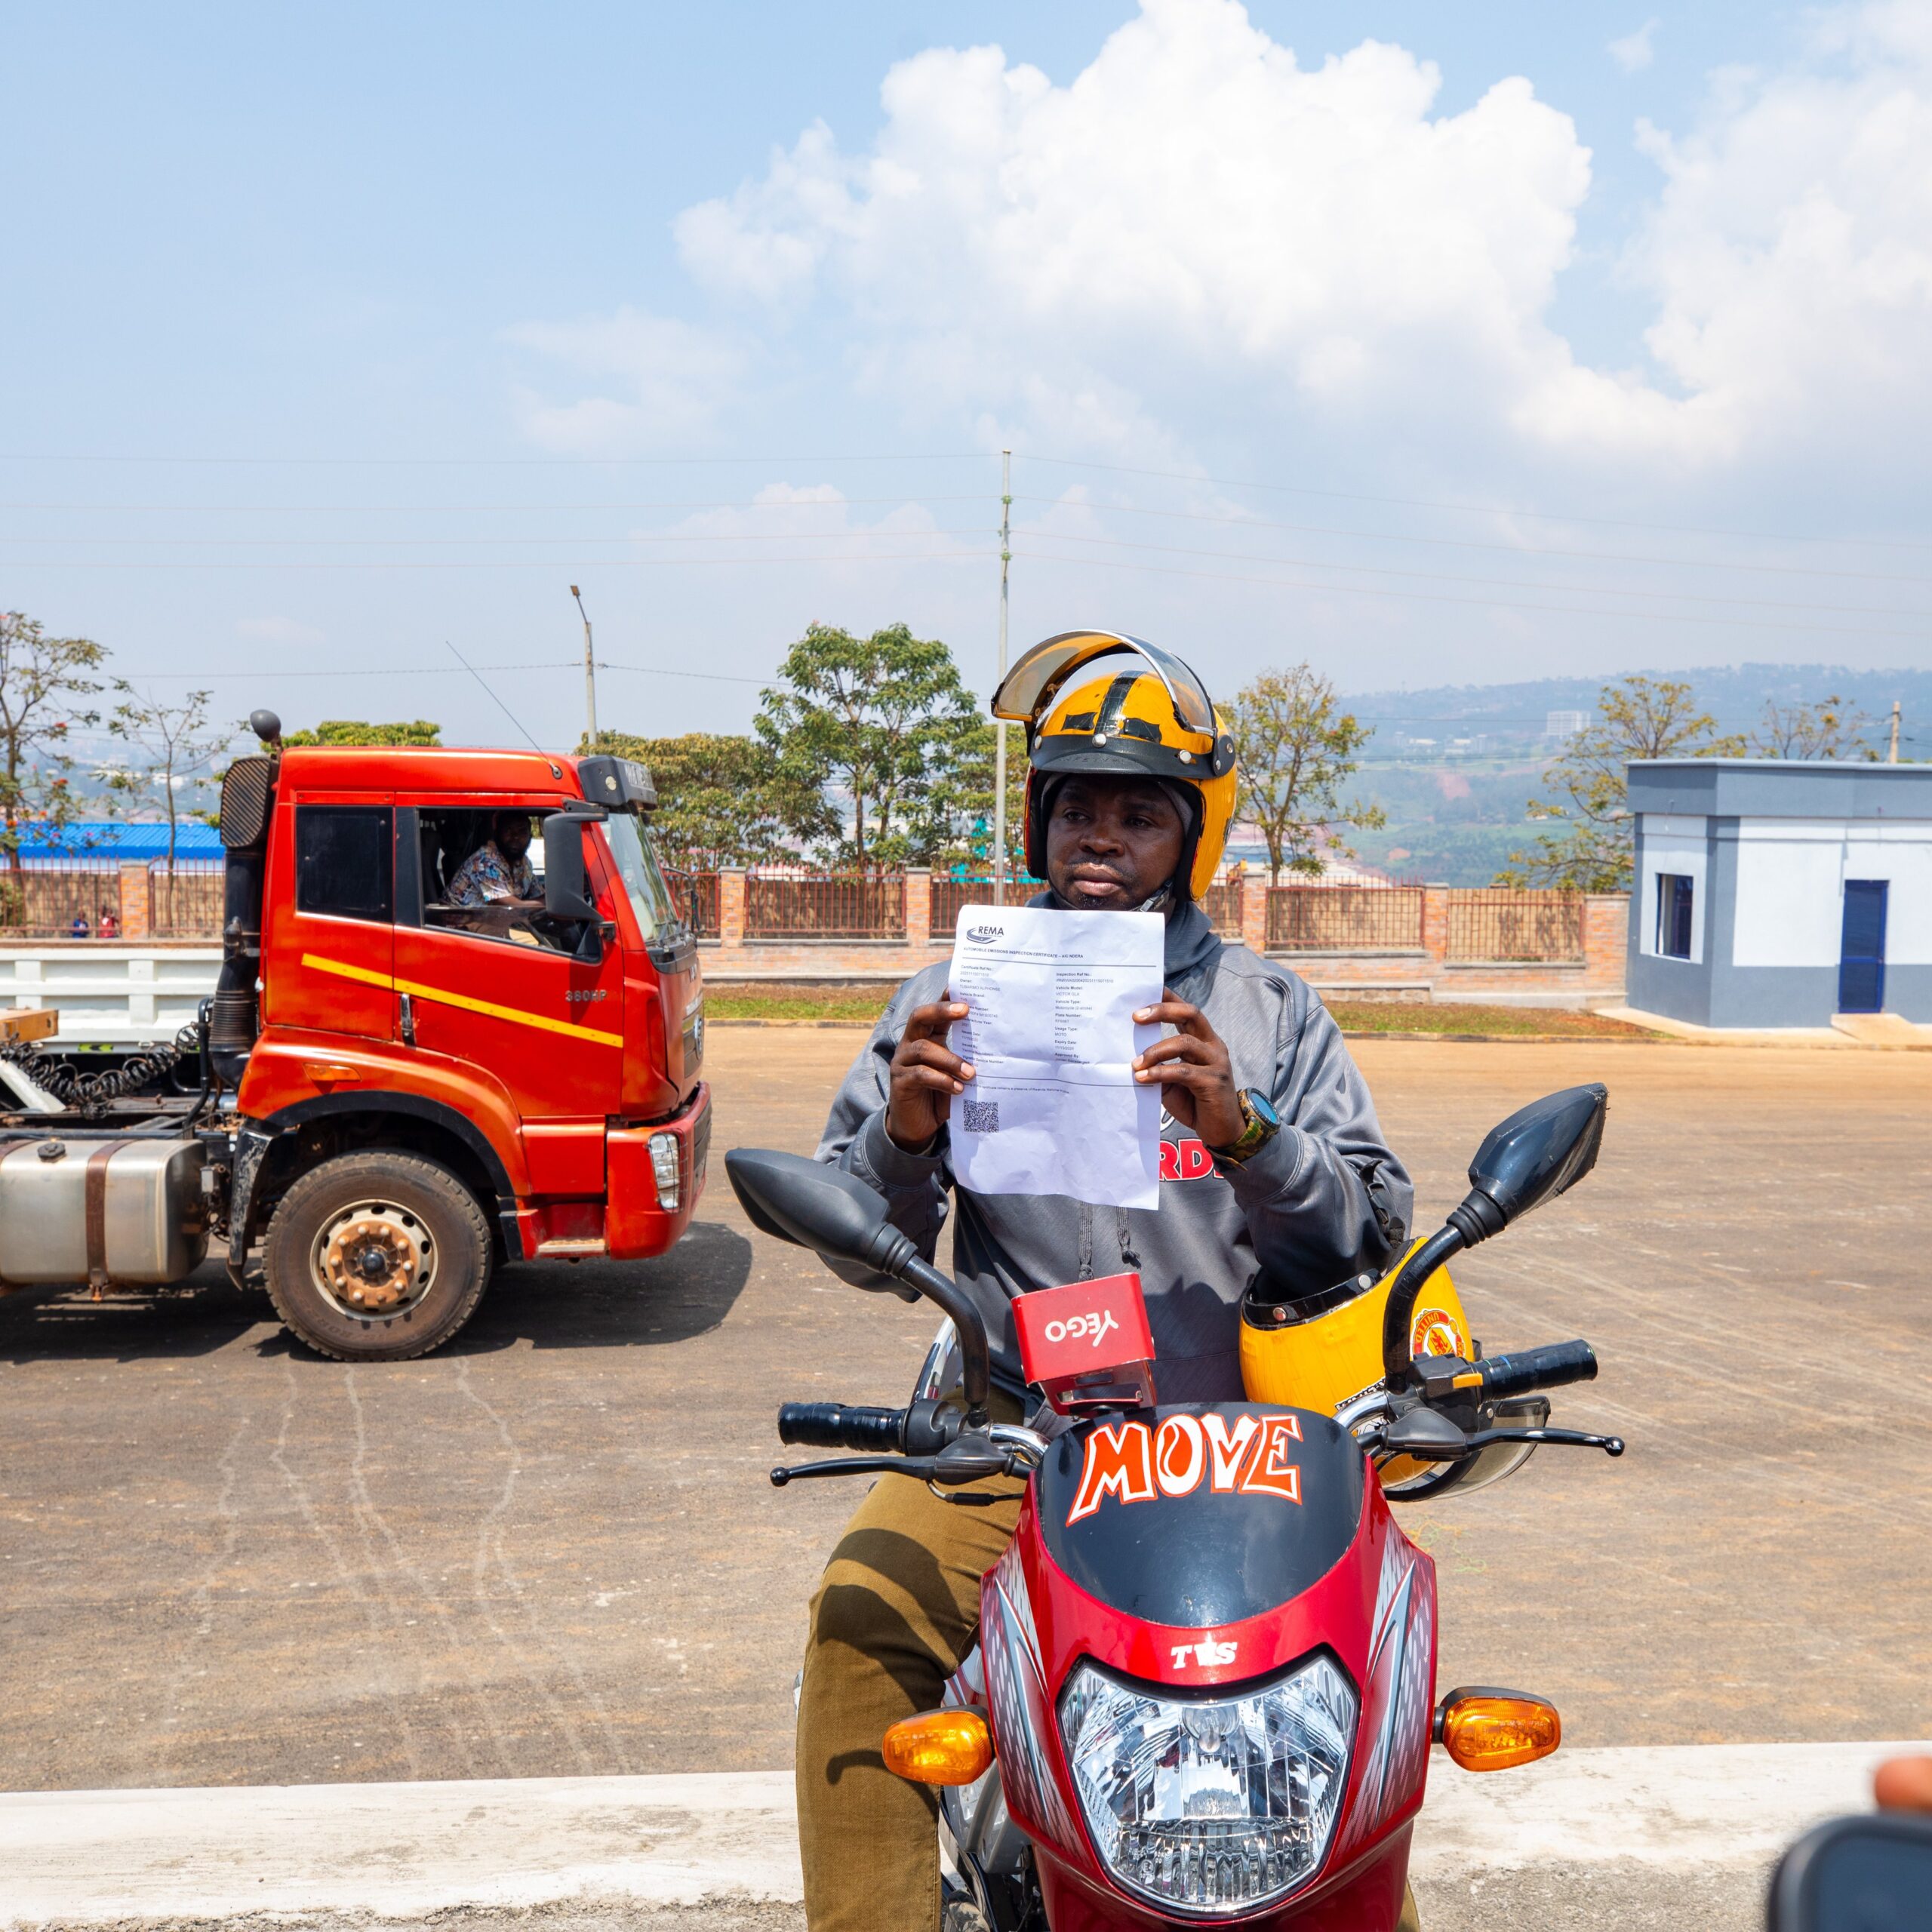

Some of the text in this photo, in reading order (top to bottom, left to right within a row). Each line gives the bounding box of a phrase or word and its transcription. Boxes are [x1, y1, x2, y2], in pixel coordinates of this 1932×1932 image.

[978, 925, 1004, 936] REMA
[1045, 1309, 1119, 1347] YEGO
[1416, 1311, 1440, 1343] UNITED
[1066, 1413, 1303, 1527] MOVE
[1171, 1641, 1238, 1669] TVS
